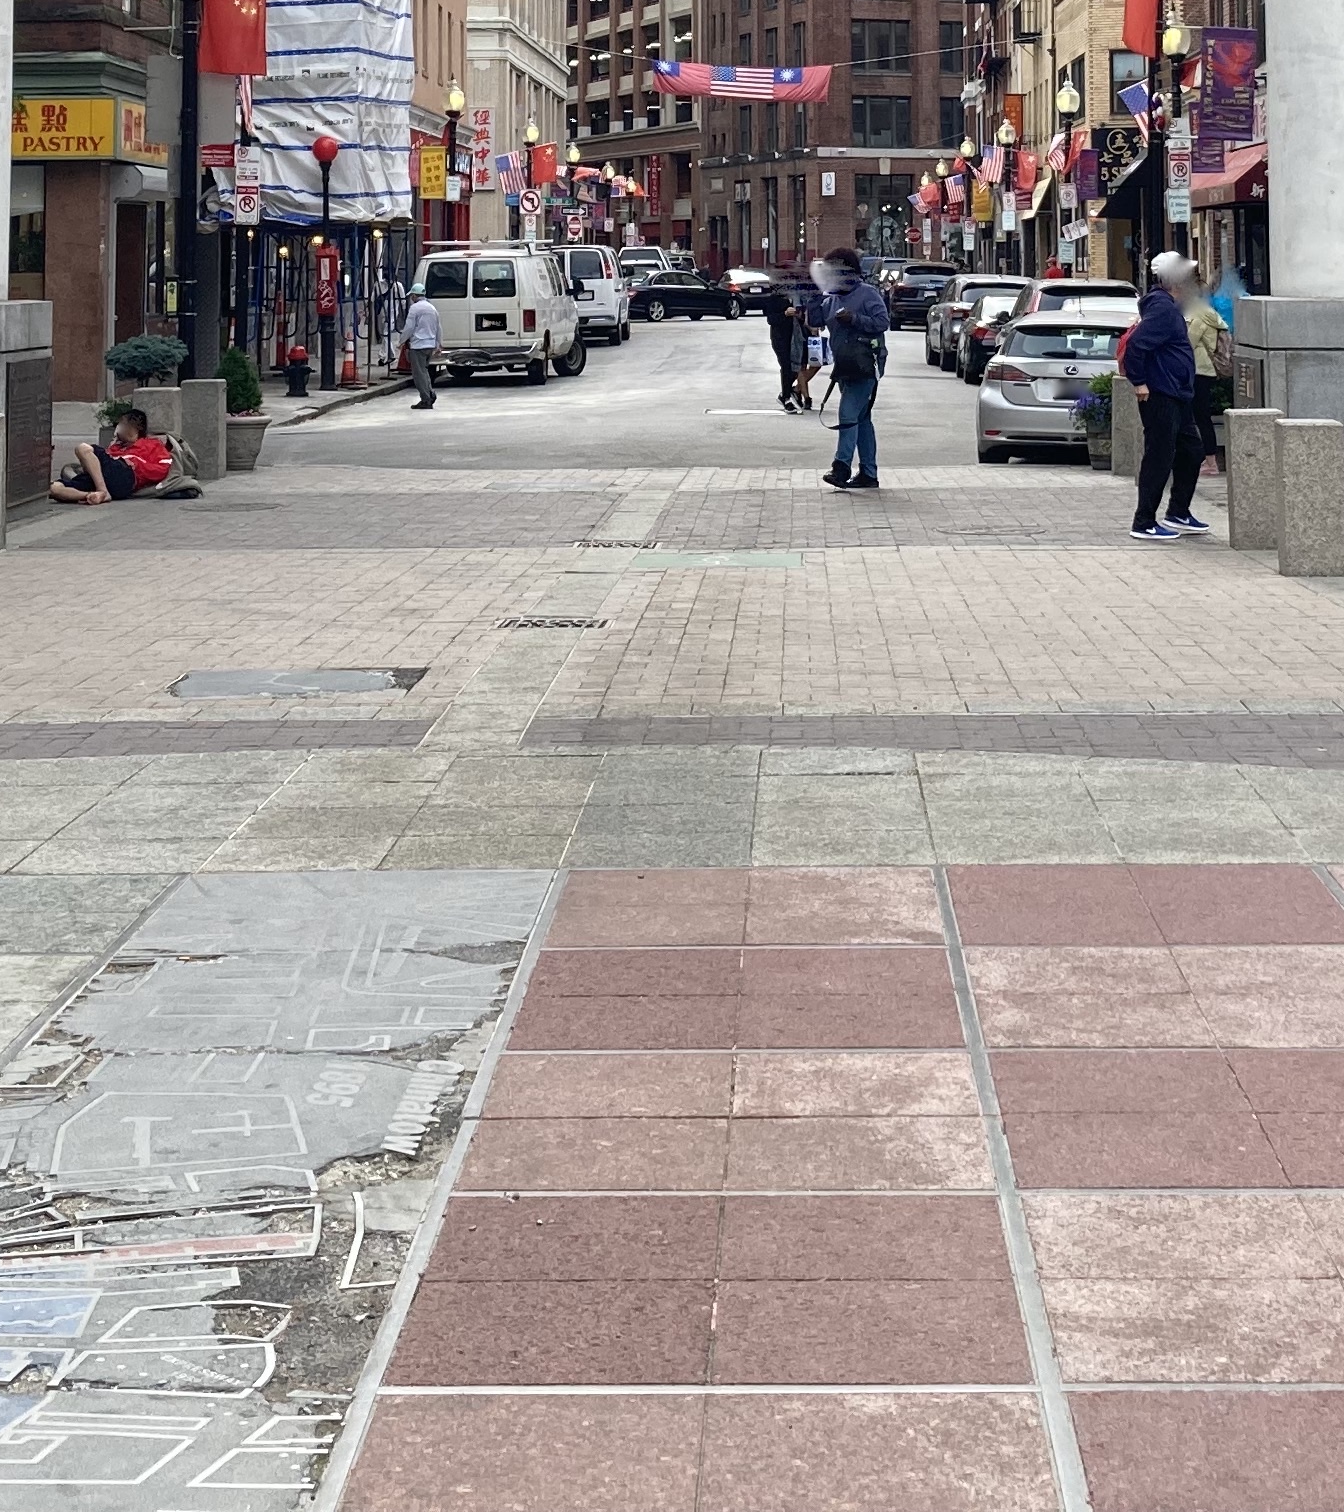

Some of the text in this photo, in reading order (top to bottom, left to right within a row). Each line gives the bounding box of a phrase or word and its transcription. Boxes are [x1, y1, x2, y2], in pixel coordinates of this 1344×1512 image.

[22, 135, 105, 153] PASTRY
[472, 109, 492, 186] 經典中華
[305, 1059, 372, 1108] 1895
